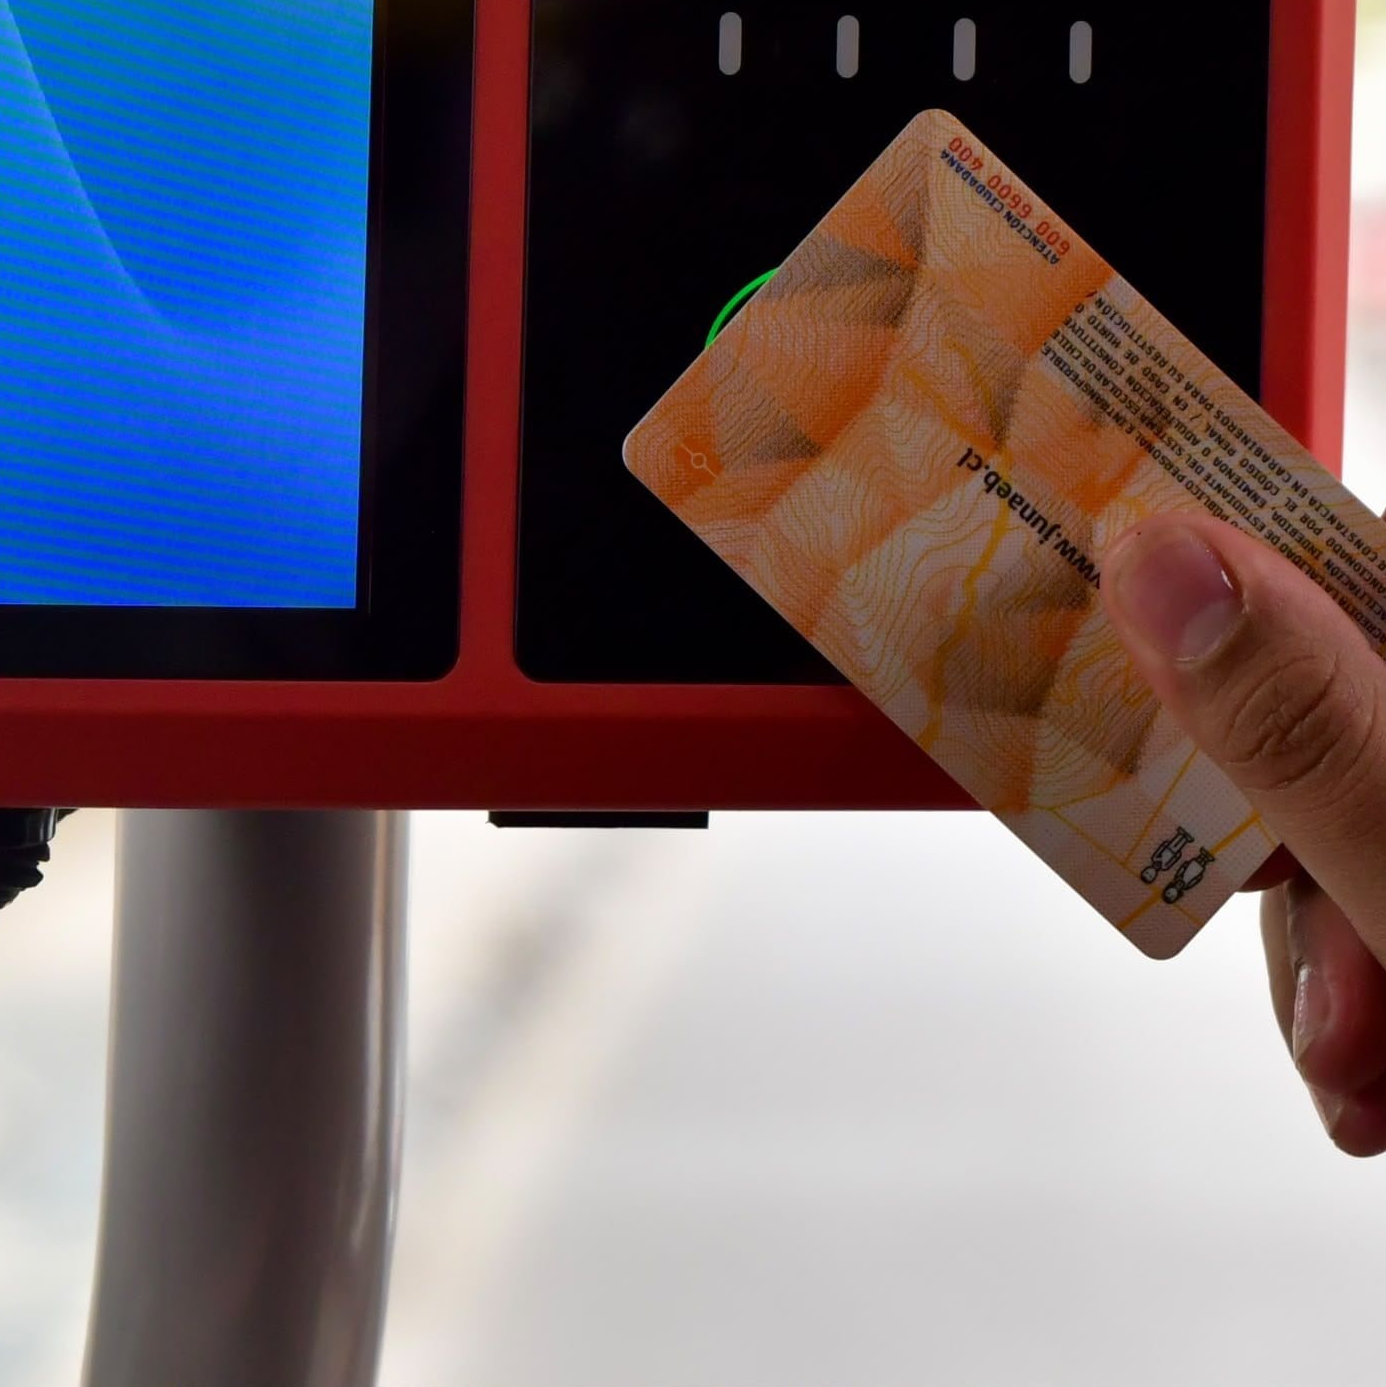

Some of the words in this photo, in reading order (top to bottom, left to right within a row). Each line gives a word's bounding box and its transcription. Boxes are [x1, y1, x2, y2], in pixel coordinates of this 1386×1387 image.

[947, 136, 985, 173] 400
[938, 148, 1005, 213] CIUDADANA
[985, 173, 1033, 219] 6600
[1001, 210, 1060, 266] ATENCIÓN
[1034, 219, 1071, 256] 600
[1050, 328, 1082, 360] CHILE
[1062, 315, 1125, 375] CONSTITUYE
[1086, 314, 1121, 347] HURTO
[1092, 296, 1168, 369] RESTITUCIÓN
[1080, 357, 1096, 373] DE
[1123, 349, 1139, 364] DE
[1166, 365, 1185, 383] SU
[1038, 341, 1127, 426] INTRANSFERIBLE,
[1093, 369, 1140, 414] ESCOLAR
[1141, 365, 1170, 393] CASO
[1183, 380, 1214, 411] PARA
[1124, 374, 1200, 447] ADULTERACIÓN
[1171, 394, 1188, 411] EN
[1138, 412, 1185, 456] SISTEMA
[1201, 422, 1237, 456] PENAL
[1213, 408, 1292, 483] CARABINEROS
[1134, 432, 1186, 482] PERSONAL
[1182, 452, 1204, 474] DEL
[1237, 456, 1280, 497] CÓDIGO
[1183, 479, 1230, 523] PÚBLICO
[1211, 455, 1267, 508] ENMIENDA
[1290, 479, 1308, 497] EN
[1203, 472, 1266, 532] ESTUDIANTE
[1281, 496, 1298, 513] EL
[1264, 529, 1280, 545] DE
[1299, 512, 1323, 536] POR
[1307, 494, 1379, 562] CONSTANCIA
[1278, 541, 1325, 587] CALIDAD
[1322, 582, 1339, 599] LA
